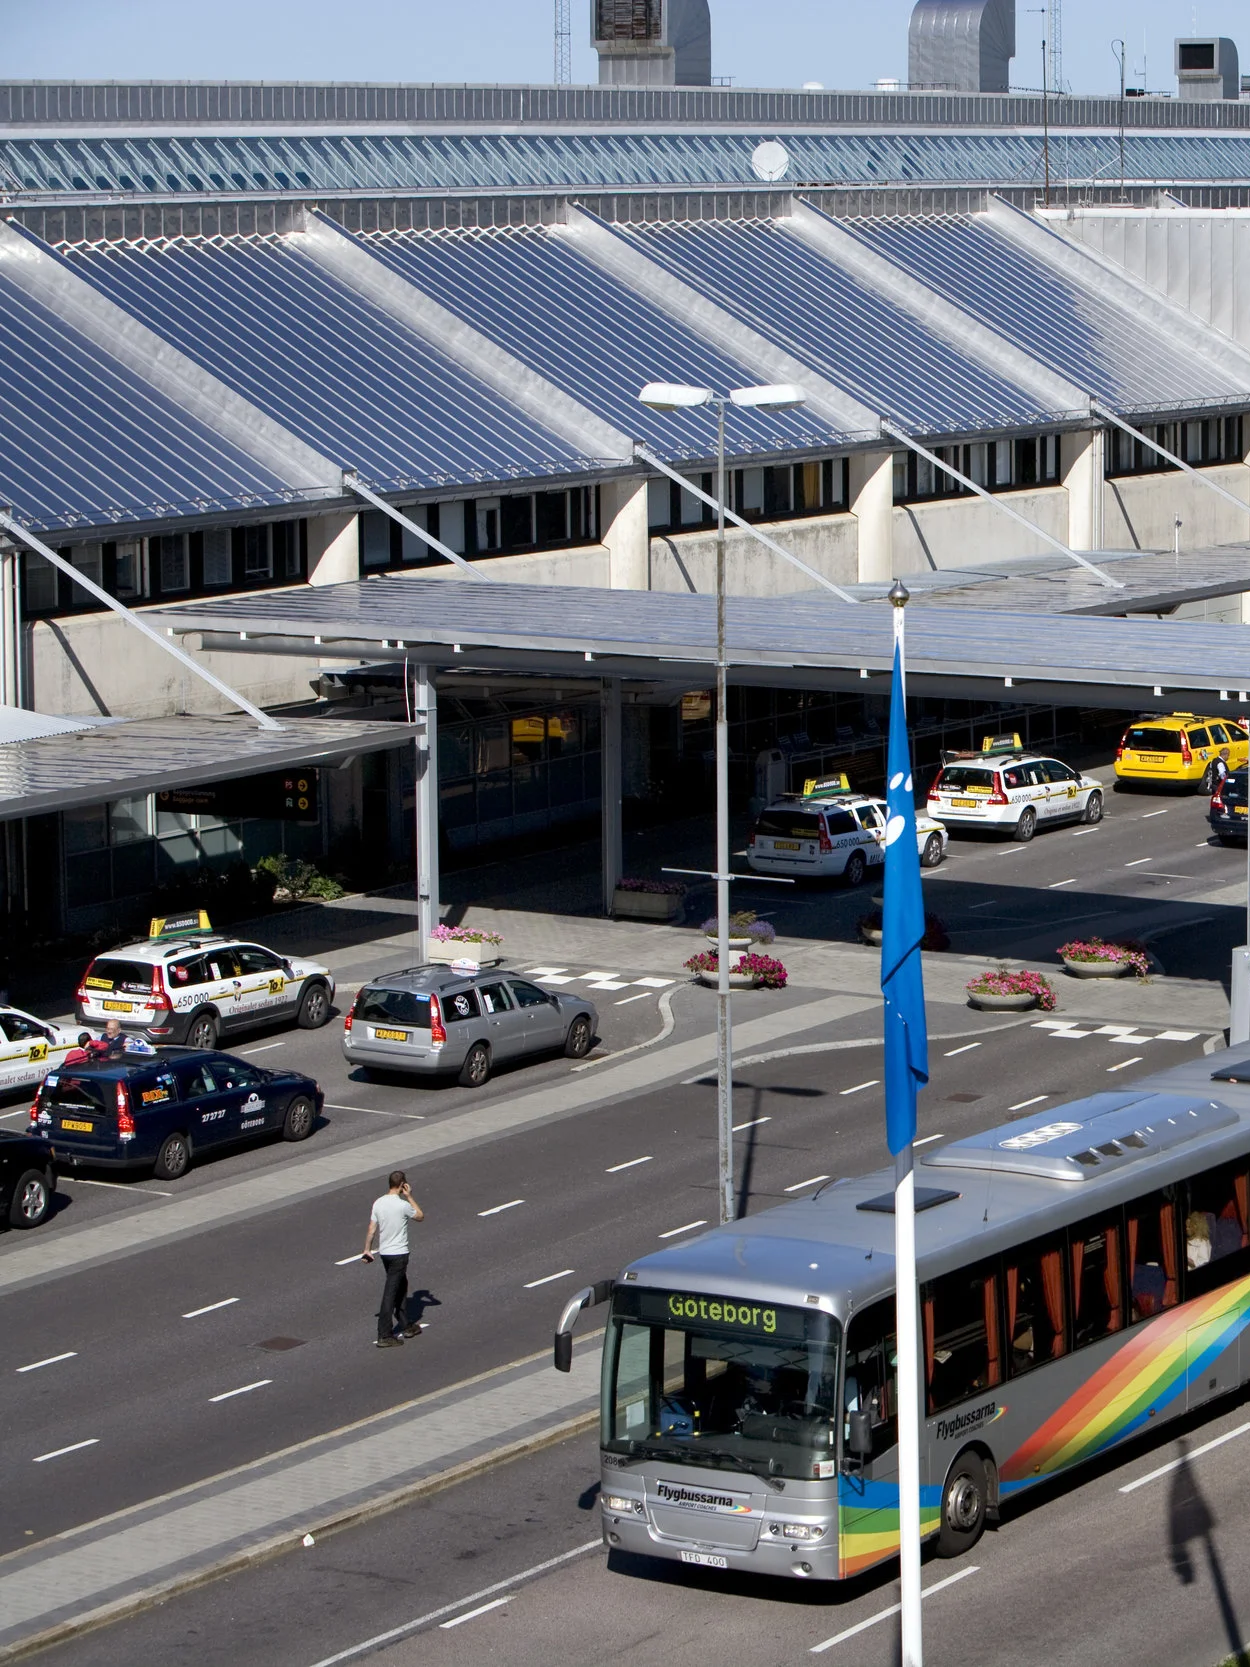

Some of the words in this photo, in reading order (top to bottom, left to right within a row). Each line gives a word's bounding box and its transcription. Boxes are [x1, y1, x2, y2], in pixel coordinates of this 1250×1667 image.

[669, 1294, 777, 1333] Göteborg
[936, 1401, 996, 1440] Flygbussarna
[657, 1484, 733, 1507] Flygbussarna
[678, 1500, 697, 1509] AIRPORT
[697, 1503, 717, 1512] COACHES
[682, 1551, 702, 1564] TFD
[706, 1555, 726, 1567] 400
